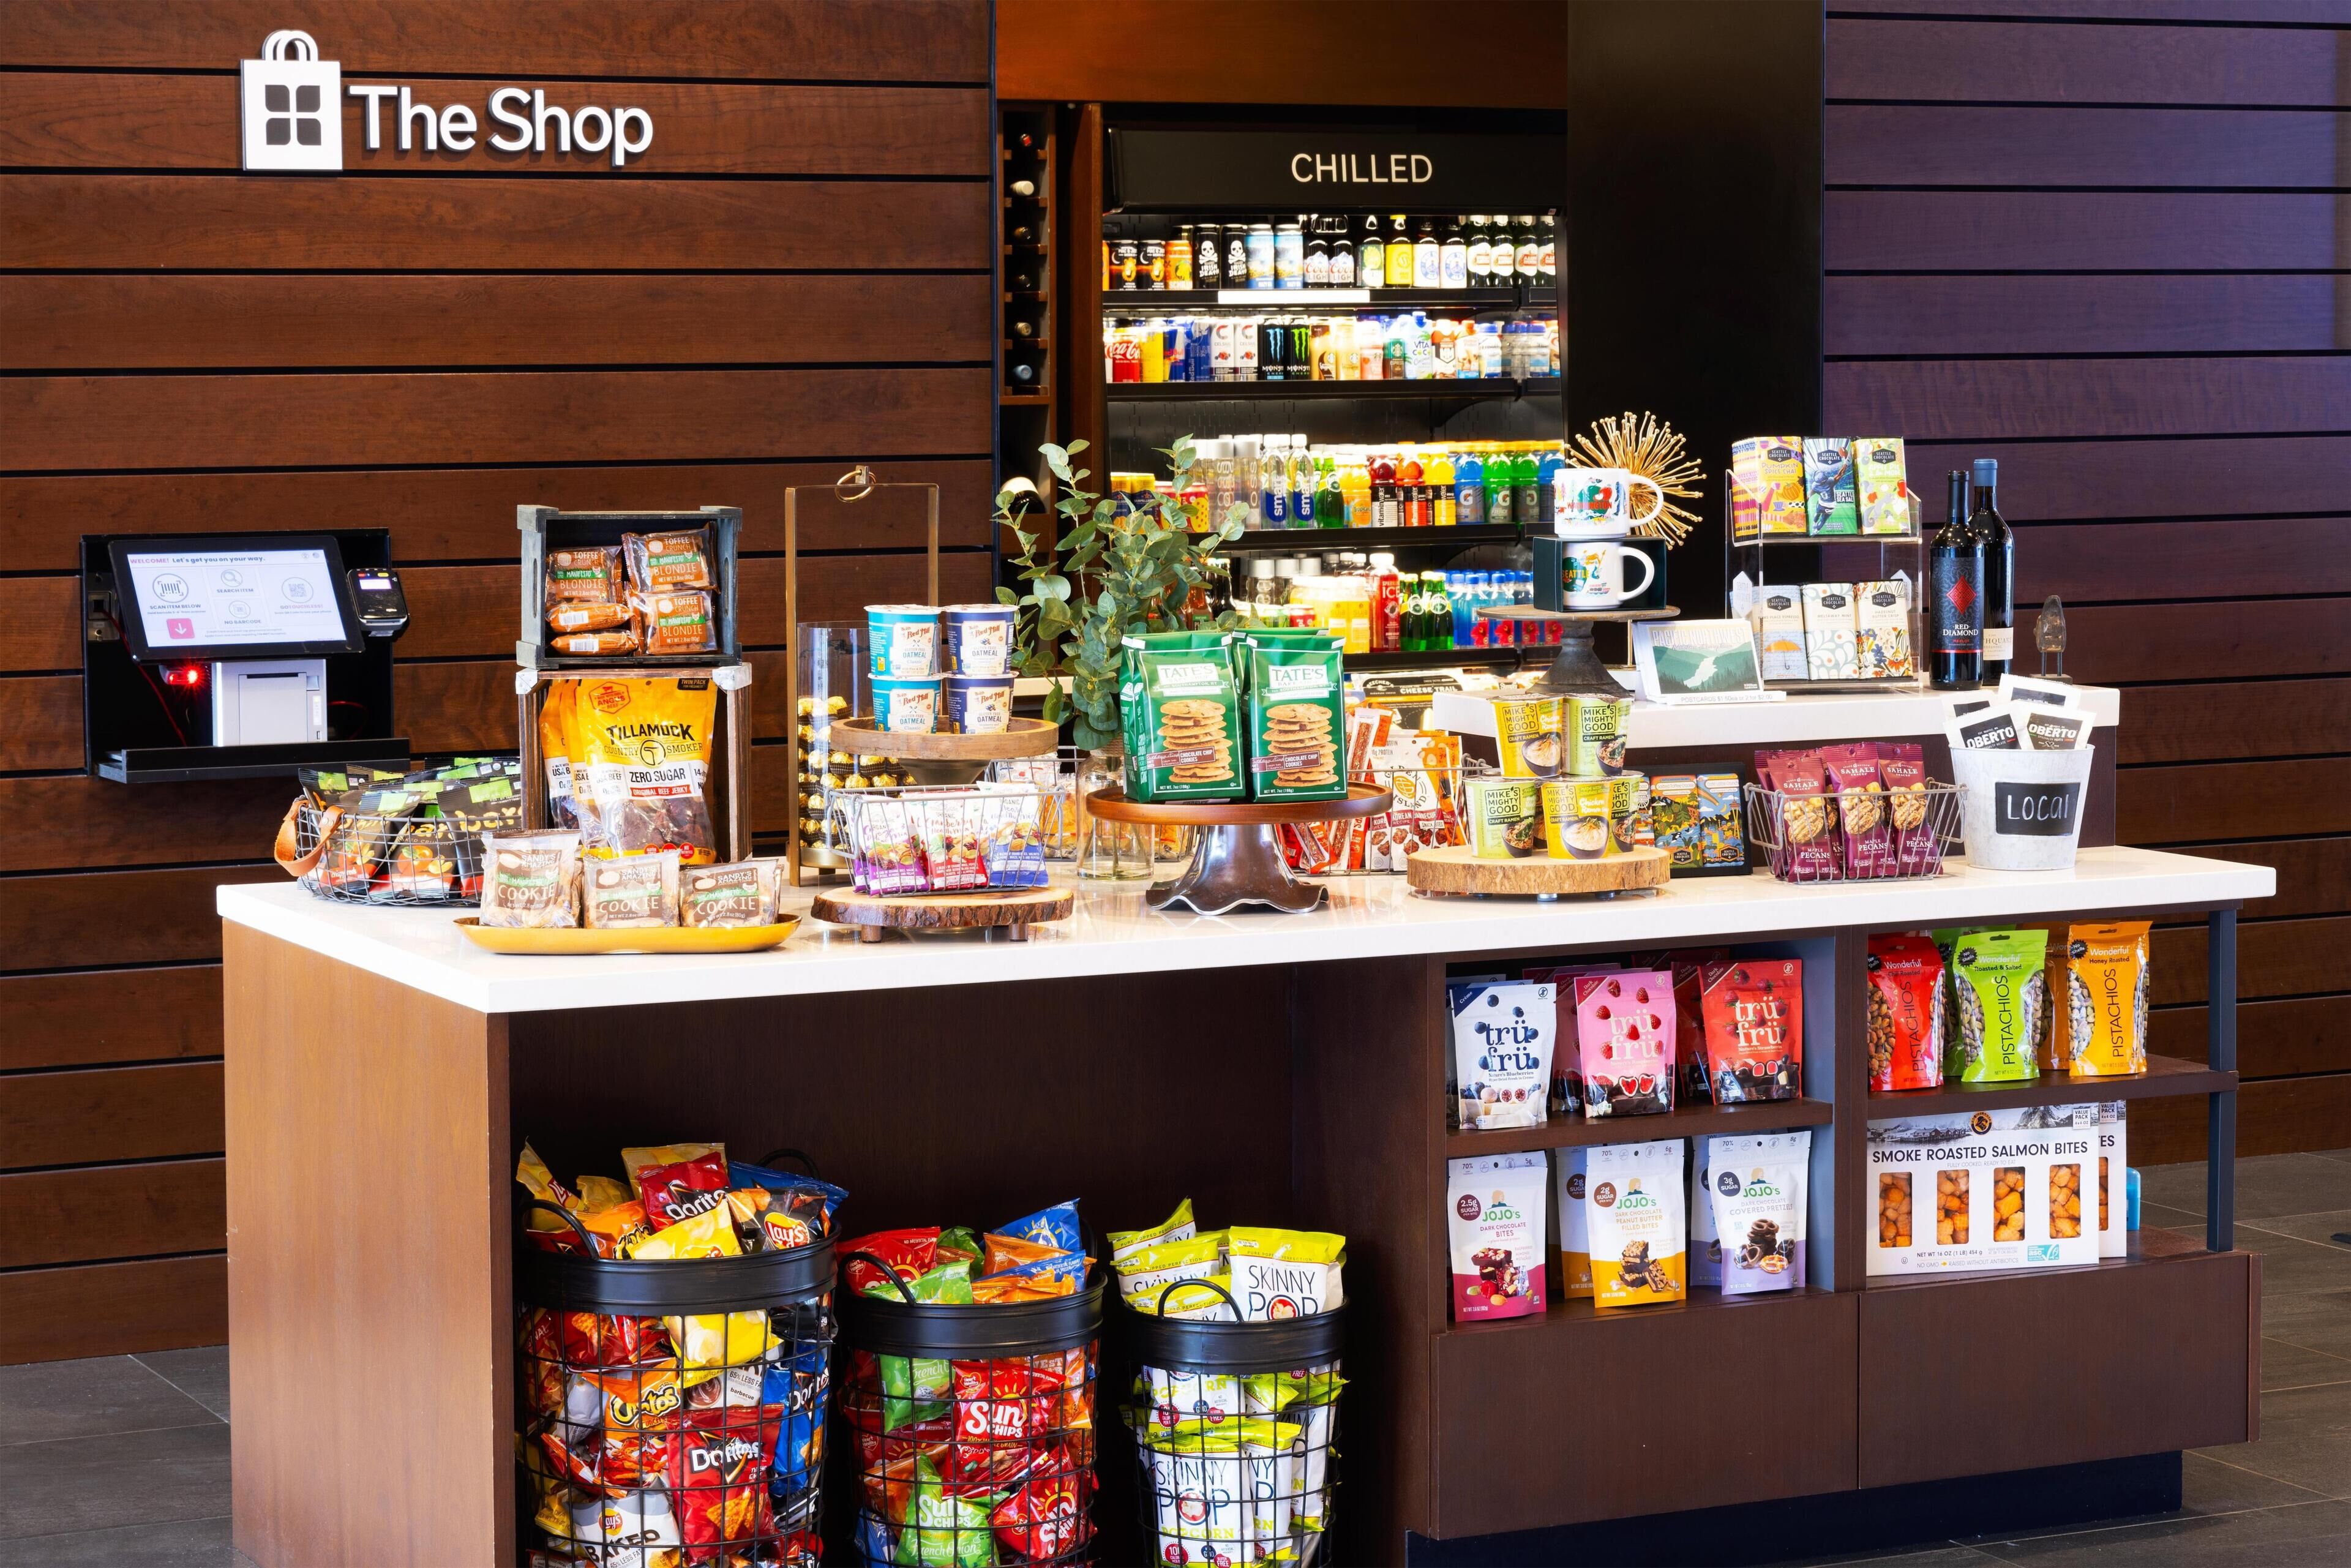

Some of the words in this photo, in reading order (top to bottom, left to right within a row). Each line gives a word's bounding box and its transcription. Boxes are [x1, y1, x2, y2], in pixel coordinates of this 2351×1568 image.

[347, 85, 477, 152] The
[488, 86, 653, 167] Shop
[1291, 154, 1432, 183] CHILLED
[560, 579, 602, 588] BLONDIE
[662, 625, 702, 636] BLONDIE
[1652, 630, 1688, 647] PACIFIC
[1272, 668, 1324, 681] TATE'S
[903, 697, 916, 705] Red
[917, 694, 928, 703] Mill
[1584, 705, 1614, 716] MIKE'S
[1506, 715, 1535, 724] MIGHTY
[1507, 722, 1536, 732] GOOD
[1967, 726, 2015, 749] OBERTO
[2028, 724, 2077, 738] OBERTO
[604, 745, 639, 756] COUNTRY
[667, 743, 703, 753] SMOKER
[629, 771, 651, 782] ZERO
[653, 768, 686, 781] SUGAR
[1488, 787, 1518, 798] MIKE'S
[1489, 805, 1518, 814] GOOD
[498, 885, 556, 900] COOKIE
[599, 895, 659, 913] COOKIE
[697, 896, 756, 917] COOKIE
[1979, 954, 2021, 964] Wonderful
[2090, 947, 2129, 956] Wonderful
[1459, 991, 1473, 1003] Crème
[1735, 996, 1780, 1021] trü
[2103, 968, 2124, 1058] PISTACHIOS
[1900, 980, 1924, 1073] PISTACHIOS
[1995, 975, 2015, 1065] PISTACHIOS
[1485, 1020, 1531, 1046] trü
[1738, 1022, 1782, 1046] frü
[1873, 1150, 1921, 1163] SMOKE
[1927, 1147, 1987, 1160] ROASTED
[1992, 1144, 2049, 1158] SALMON
[2055, 1141, 2088, 1155] BITES
[767, 1220, 808, 1247] Lay's
[1496, 1222, 1526, 1231] CHOCOLATE
[1248, 1265, 1315, 1294] SKINNY
[1248, 1291, 1318, 1321] POP
[730, 1387, 755, 1401] barbecue
[965, 1400, 1025, 1434] Sun
[986, 1424, 1024, 1438] CHIPS
[691, 1440, 763, 1471] Doritos
[1157, 1457, 1227, 1486] SKINNY
[918, 1493, 972, 1527] Sun
[1158, 1487, 1230, 1526] POP
[934, 1515, 972, 1528] CHIPS
[1161, 1526, 1235, 1539] POPCORN
[585, 1528, 661, 1563] BAKED
